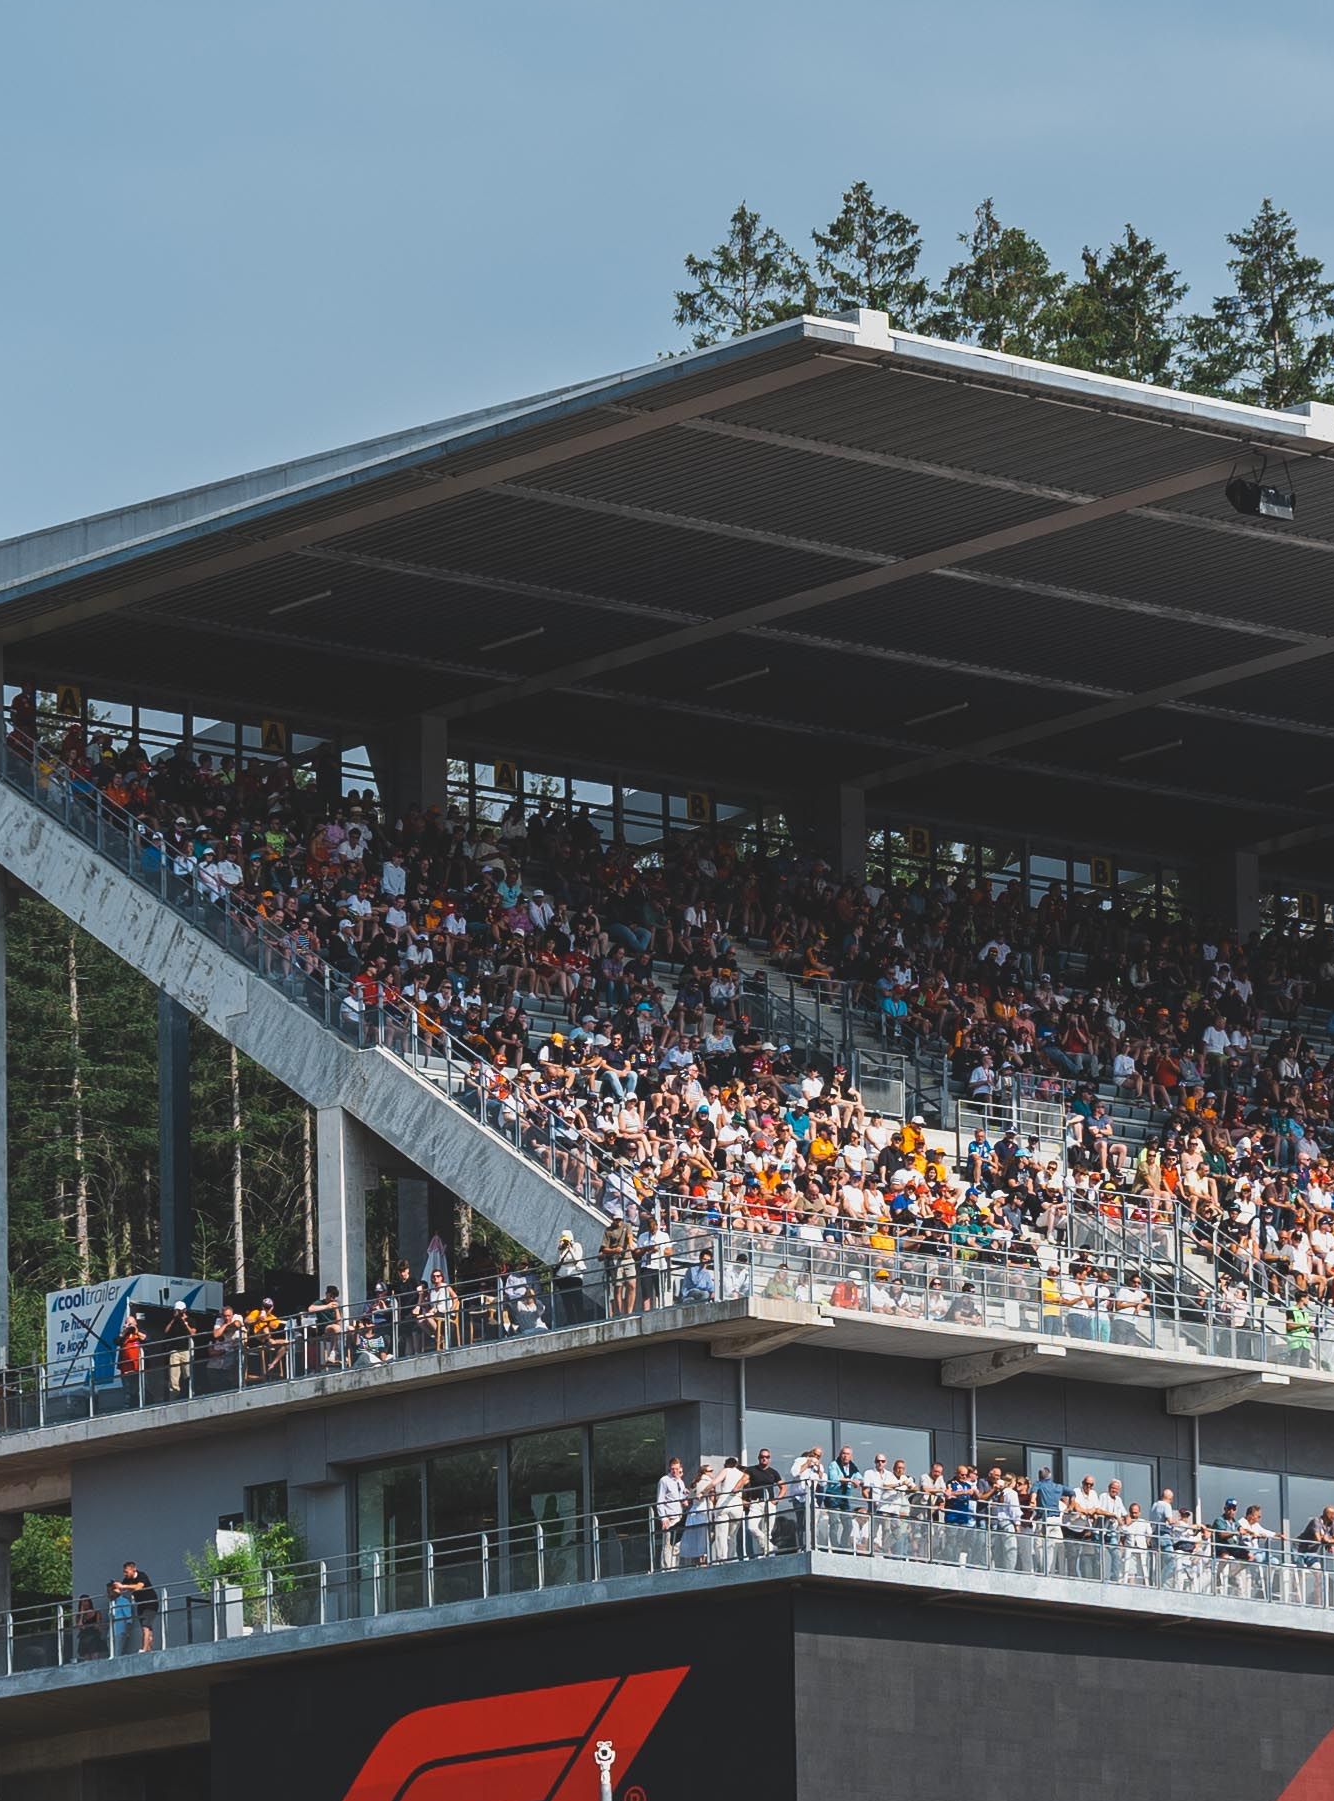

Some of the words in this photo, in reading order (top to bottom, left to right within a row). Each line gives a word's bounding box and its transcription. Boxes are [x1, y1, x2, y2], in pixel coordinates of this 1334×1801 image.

[60, 687, 79, 712] A
[264, 723, 284, 749] A
[496, 761, 515, 787] A
[689, 794, 704, 820] B
[912, 828, 926, 854] B
[1093, 860, 1107, 885] B
[60, 1319, 71, 1333] Te
[56, 1341, 66, 1355] Te
